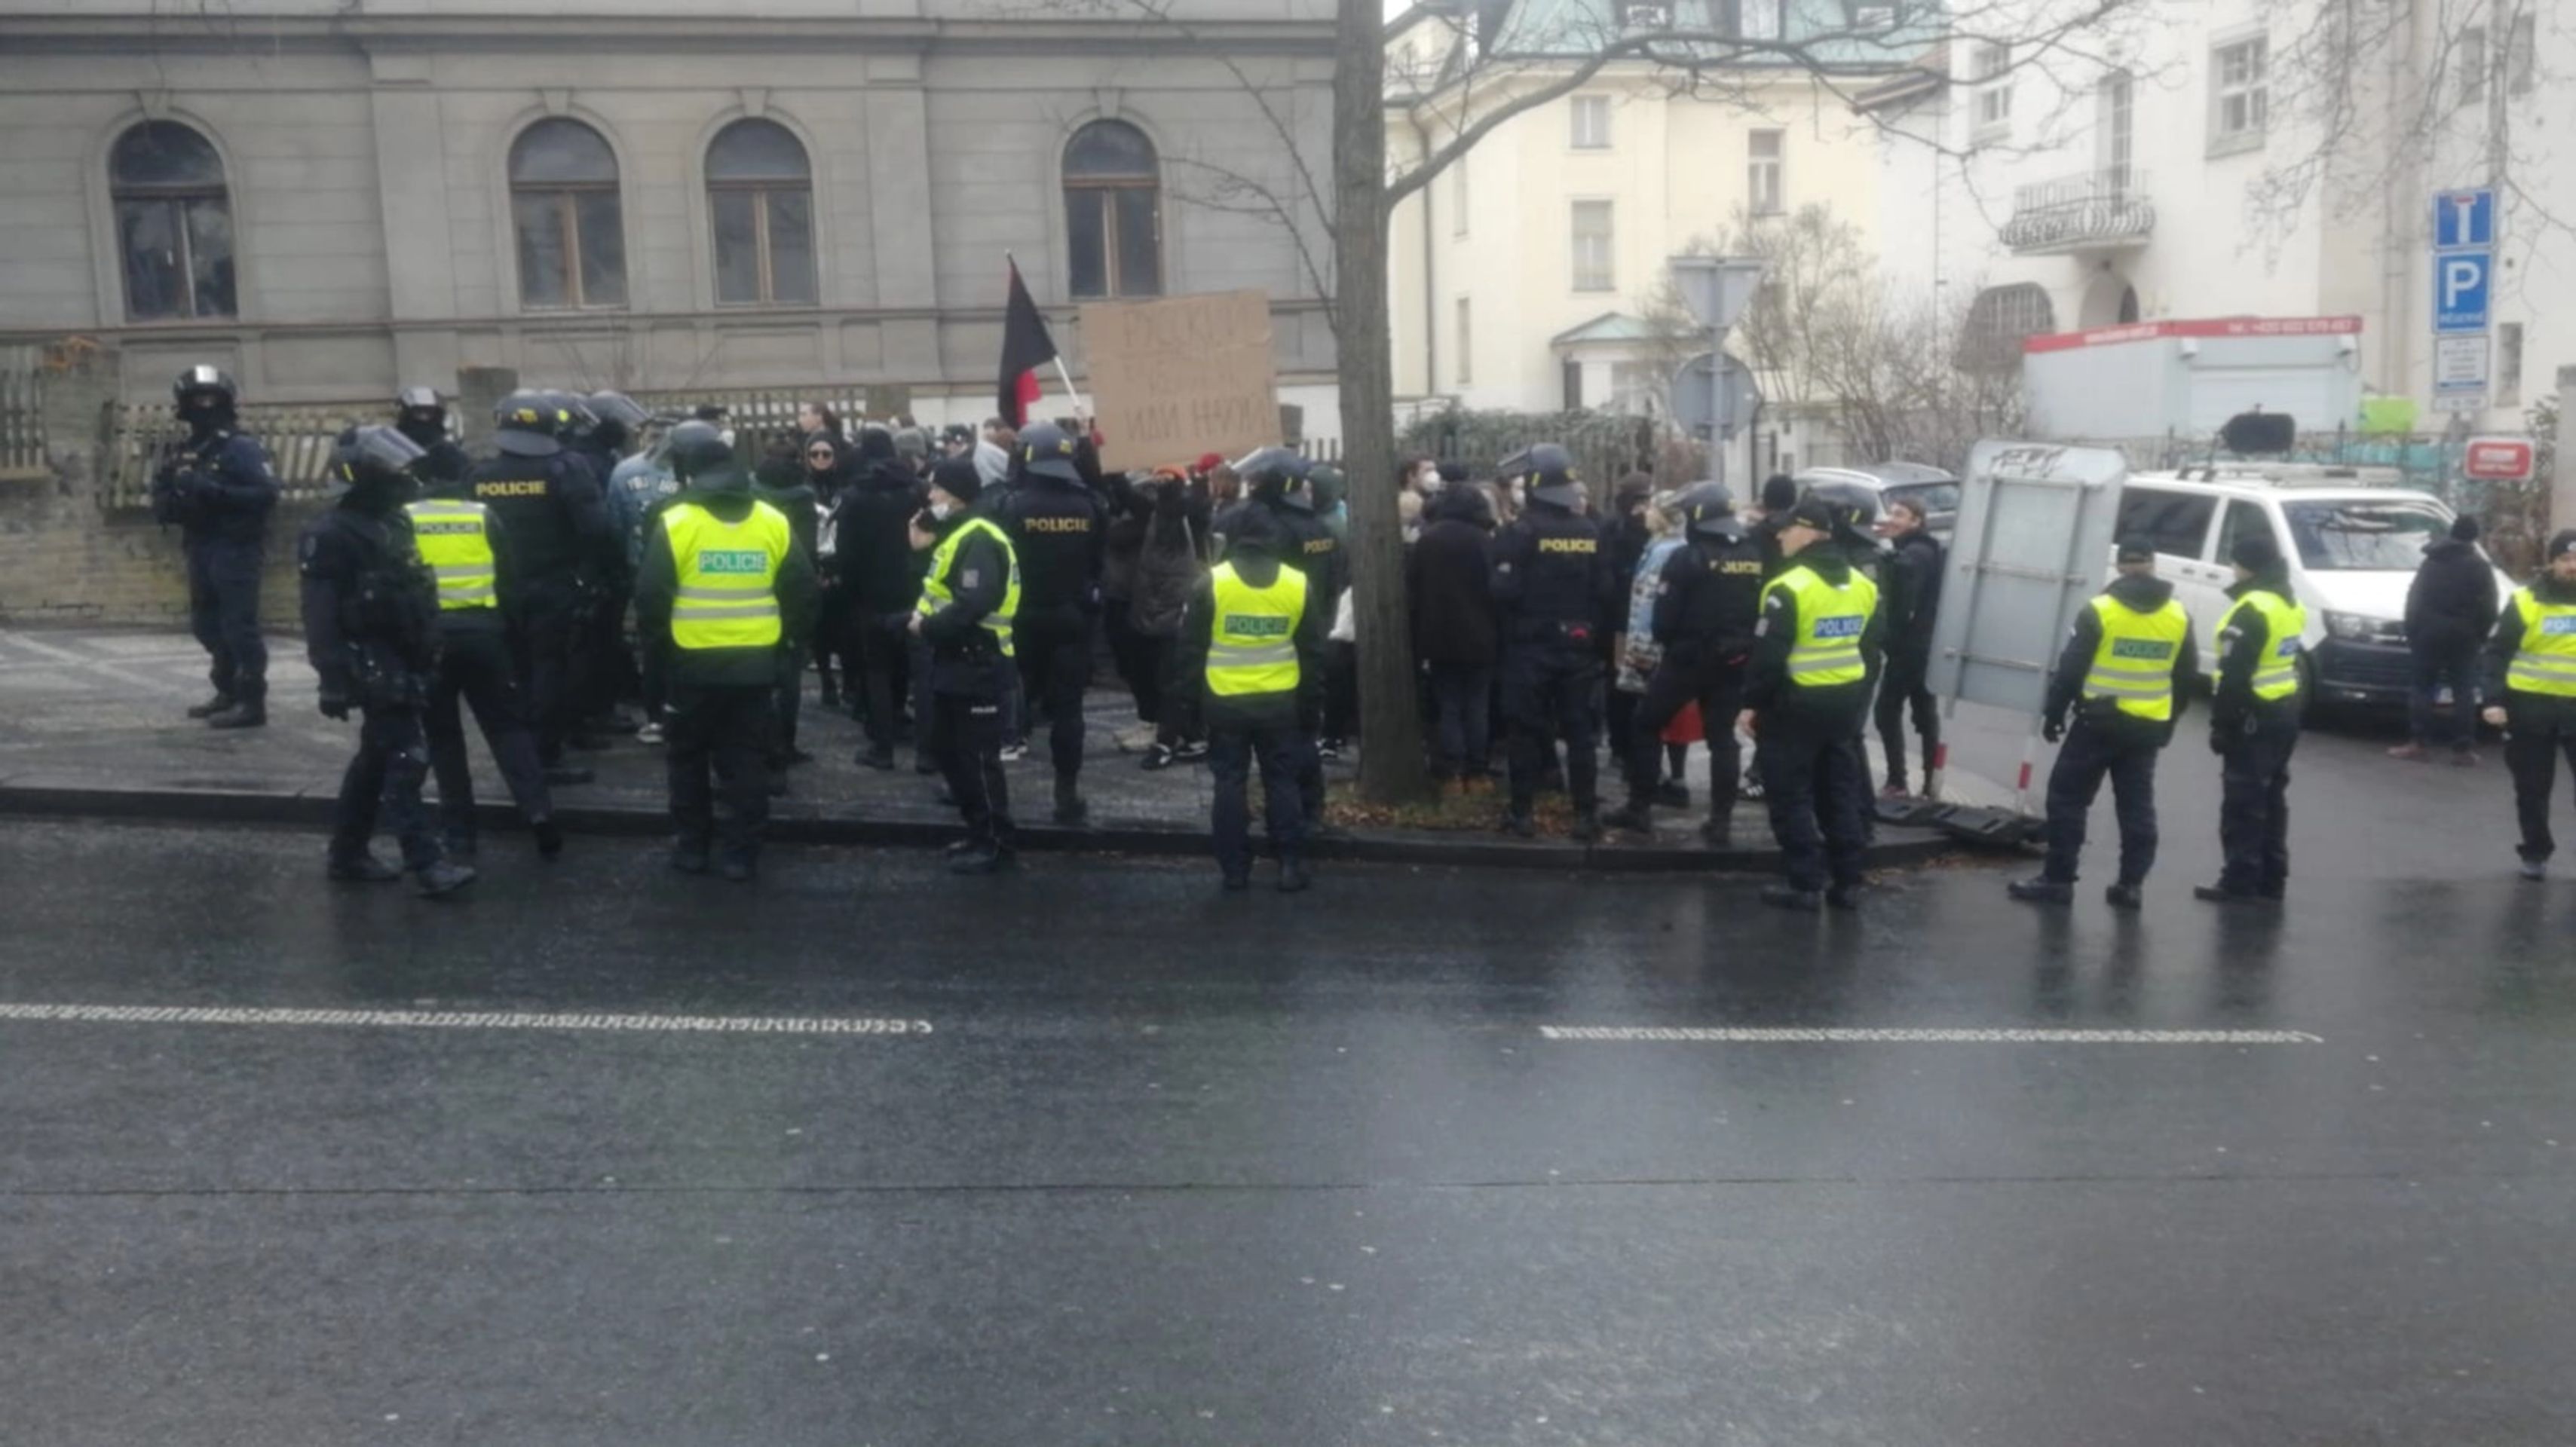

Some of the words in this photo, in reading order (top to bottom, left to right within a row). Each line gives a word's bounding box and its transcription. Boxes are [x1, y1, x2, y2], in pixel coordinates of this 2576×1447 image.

[2446, 261, 2480, 308] P
[475, 481, 547, 497] POLICIE
[418, 522, 479, 534] POLICIE
[1024, 517, 1091, 532] POLICIE
[1539, 538, 1597, 552] POLICIE
[700, 553, 765, 571] POLICIE
[1226, 617, 1288, 634] POLICIE
[2114, 640, 2170, 658] POLICIE
